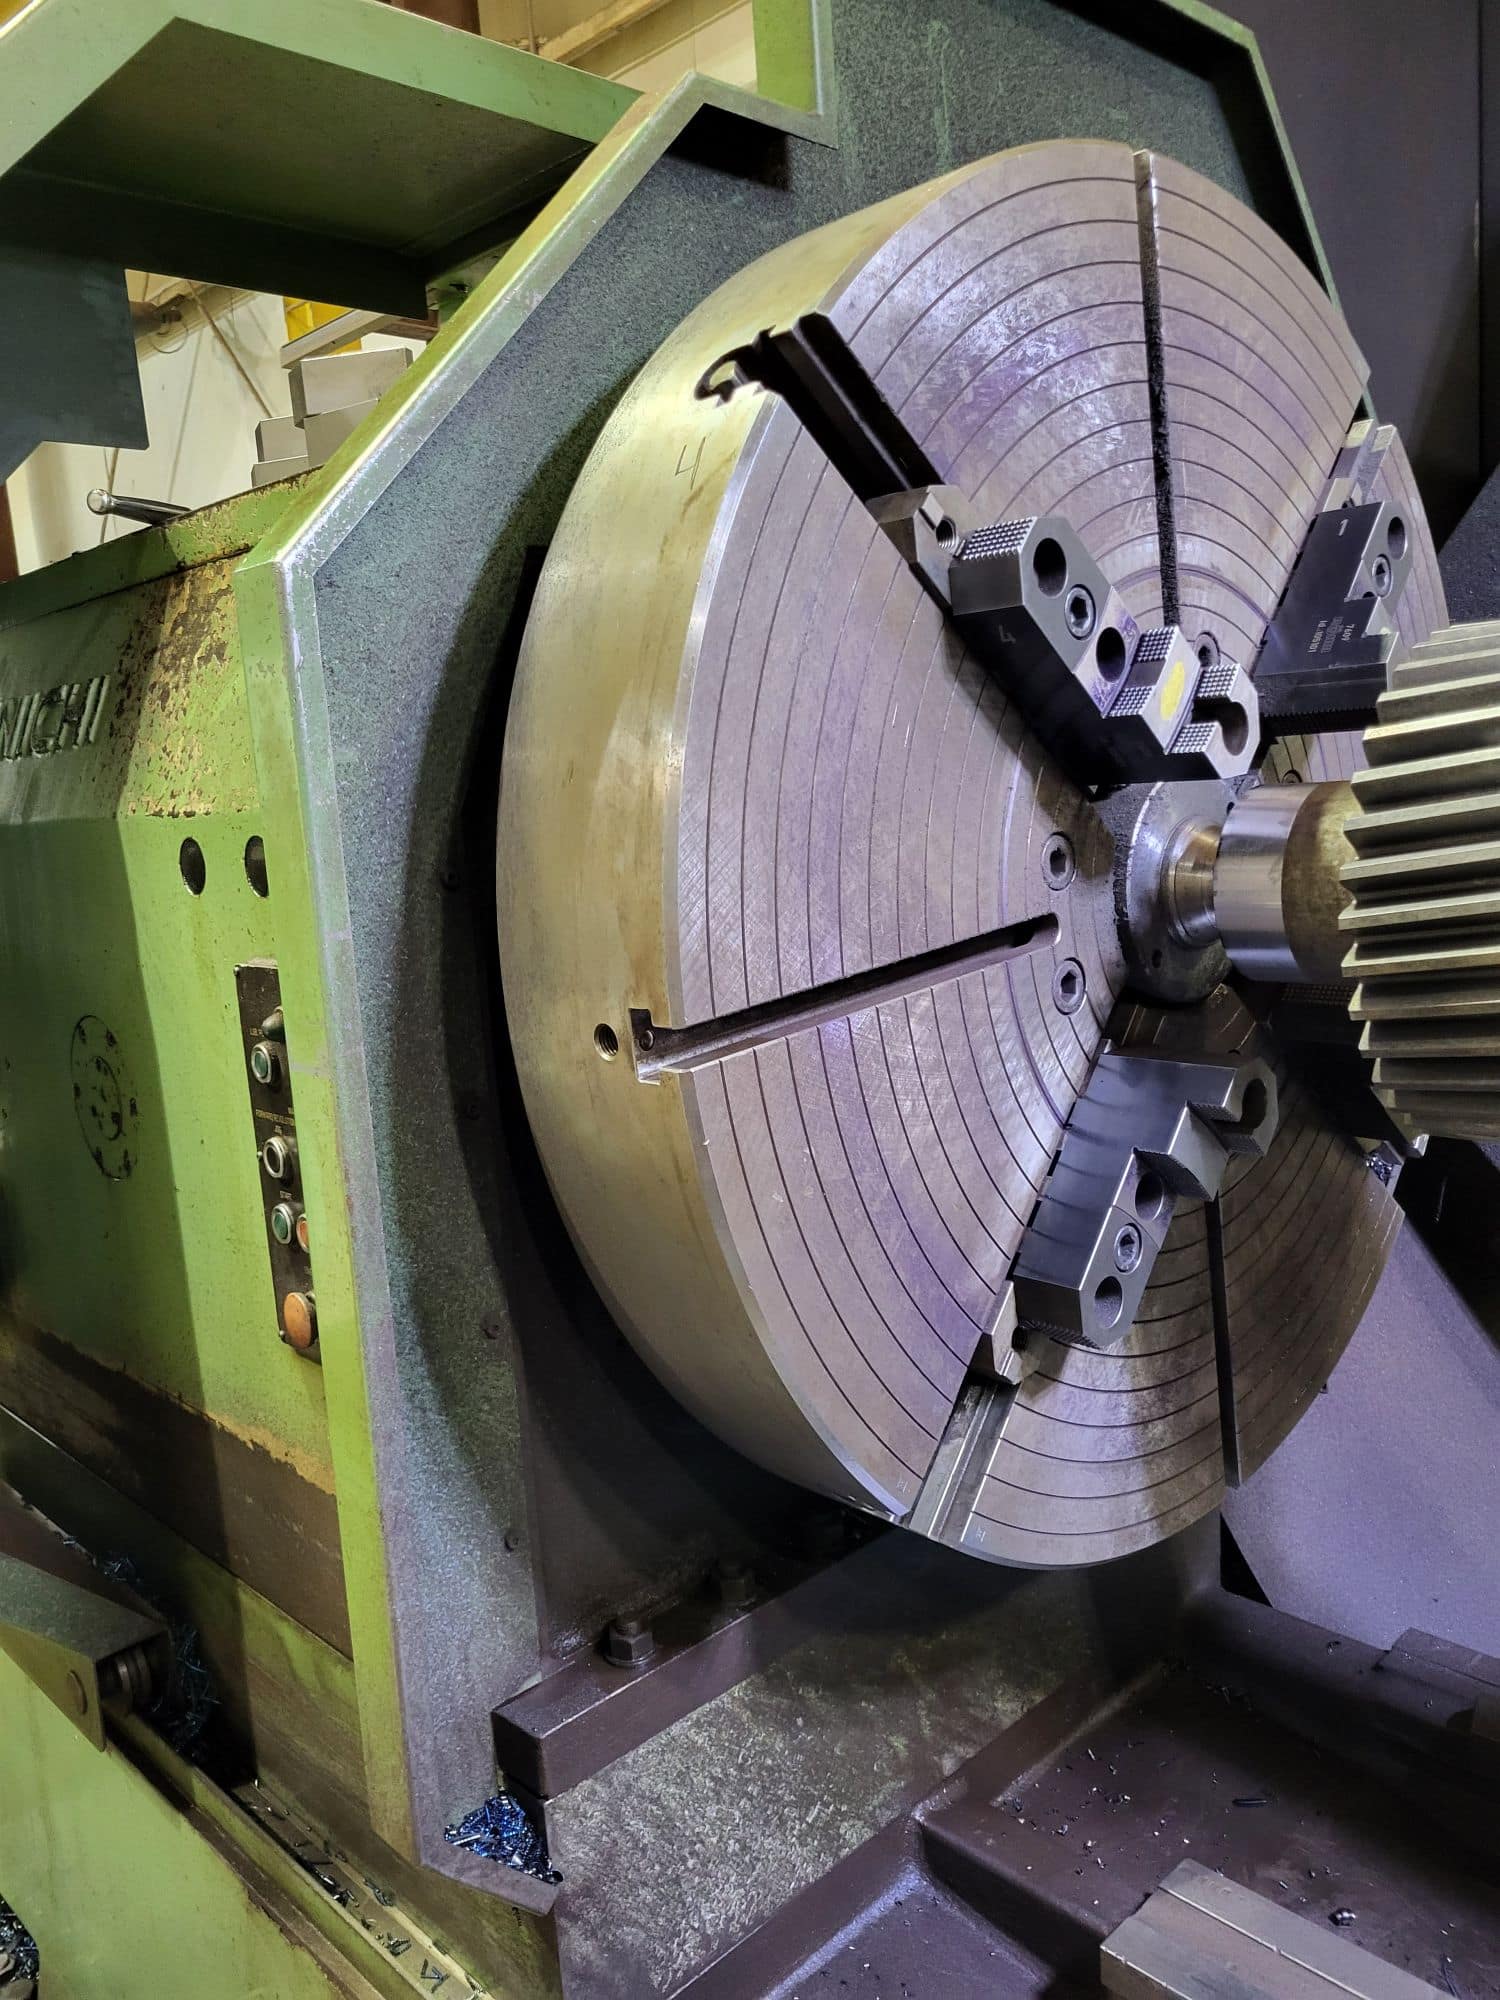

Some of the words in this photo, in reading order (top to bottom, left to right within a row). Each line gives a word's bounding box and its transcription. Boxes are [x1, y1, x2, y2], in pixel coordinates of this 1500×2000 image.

[674, 435, 708, 491] 4
[1337, 518, 1350, 537] 1
[998, 623, 1017, 645] 4
